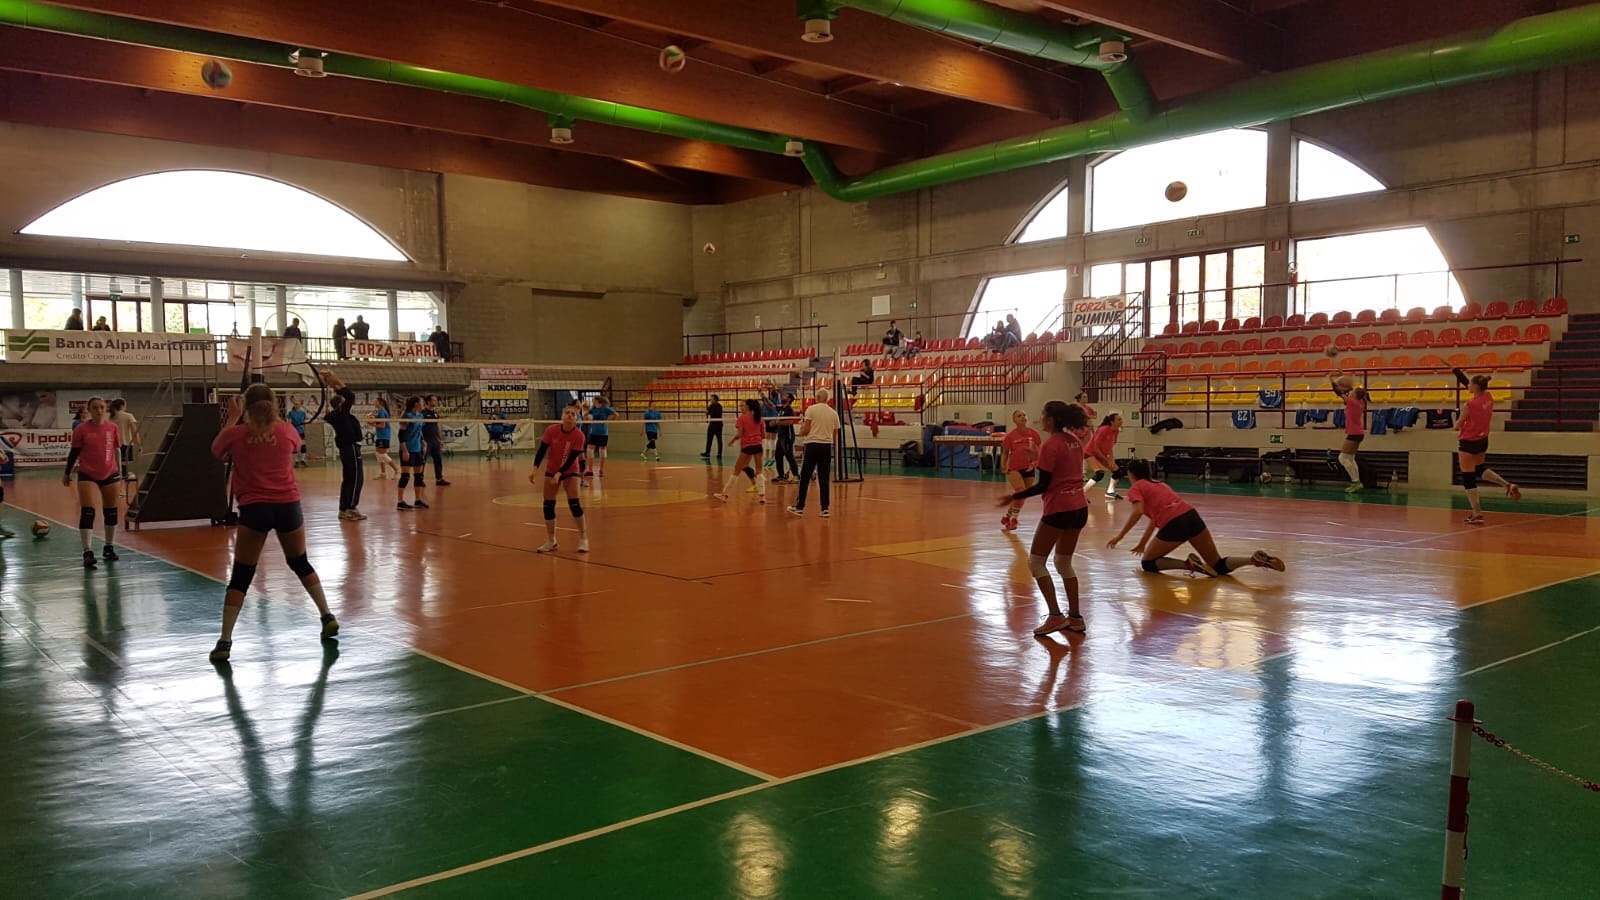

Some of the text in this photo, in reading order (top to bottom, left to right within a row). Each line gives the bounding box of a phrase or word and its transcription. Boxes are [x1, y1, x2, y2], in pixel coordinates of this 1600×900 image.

[1074, 301, 1106, 313] FORZA
[55, 338, 103, 349] Banca
[104, 338, 135, 352] Alpi
[350, 342, 393, 357] FORZA
[482, 399, 528, 408] KAESER
[442, 425, 470, 438] mat
[38, 431, 72, 446] podi
